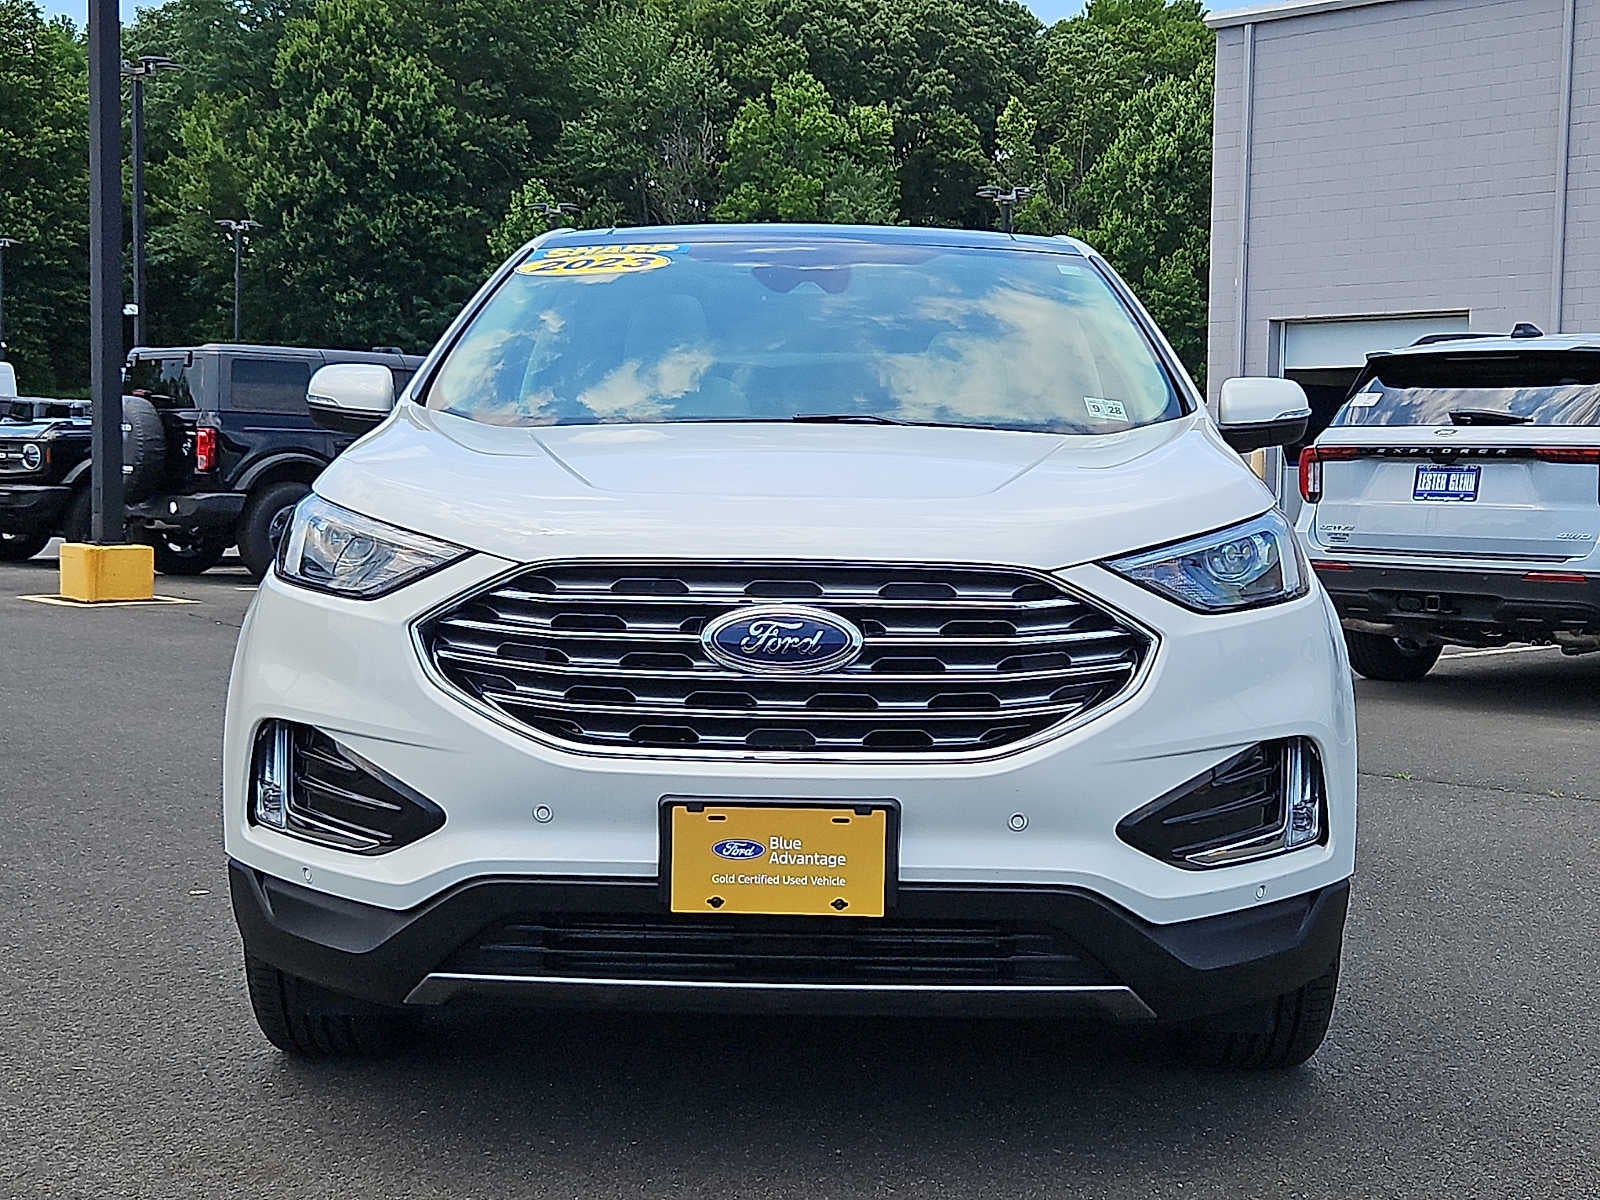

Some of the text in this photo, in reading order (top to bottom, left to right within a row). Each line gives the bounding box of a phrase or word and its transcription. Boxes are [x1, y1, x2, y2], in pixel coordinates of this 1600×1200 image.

[531, 257, 656, 272] 2023
[1416, 473, 1476, 492] LESTER GLENN
[740, 620, 824, 655] Ford
[722, 841, 755, 856] Ford
[769, 836, 802, 850] Blue
[768, 852, 847, 868] Advantage
[711, 874, 846, 887] Gold Certified Used Vehicle
